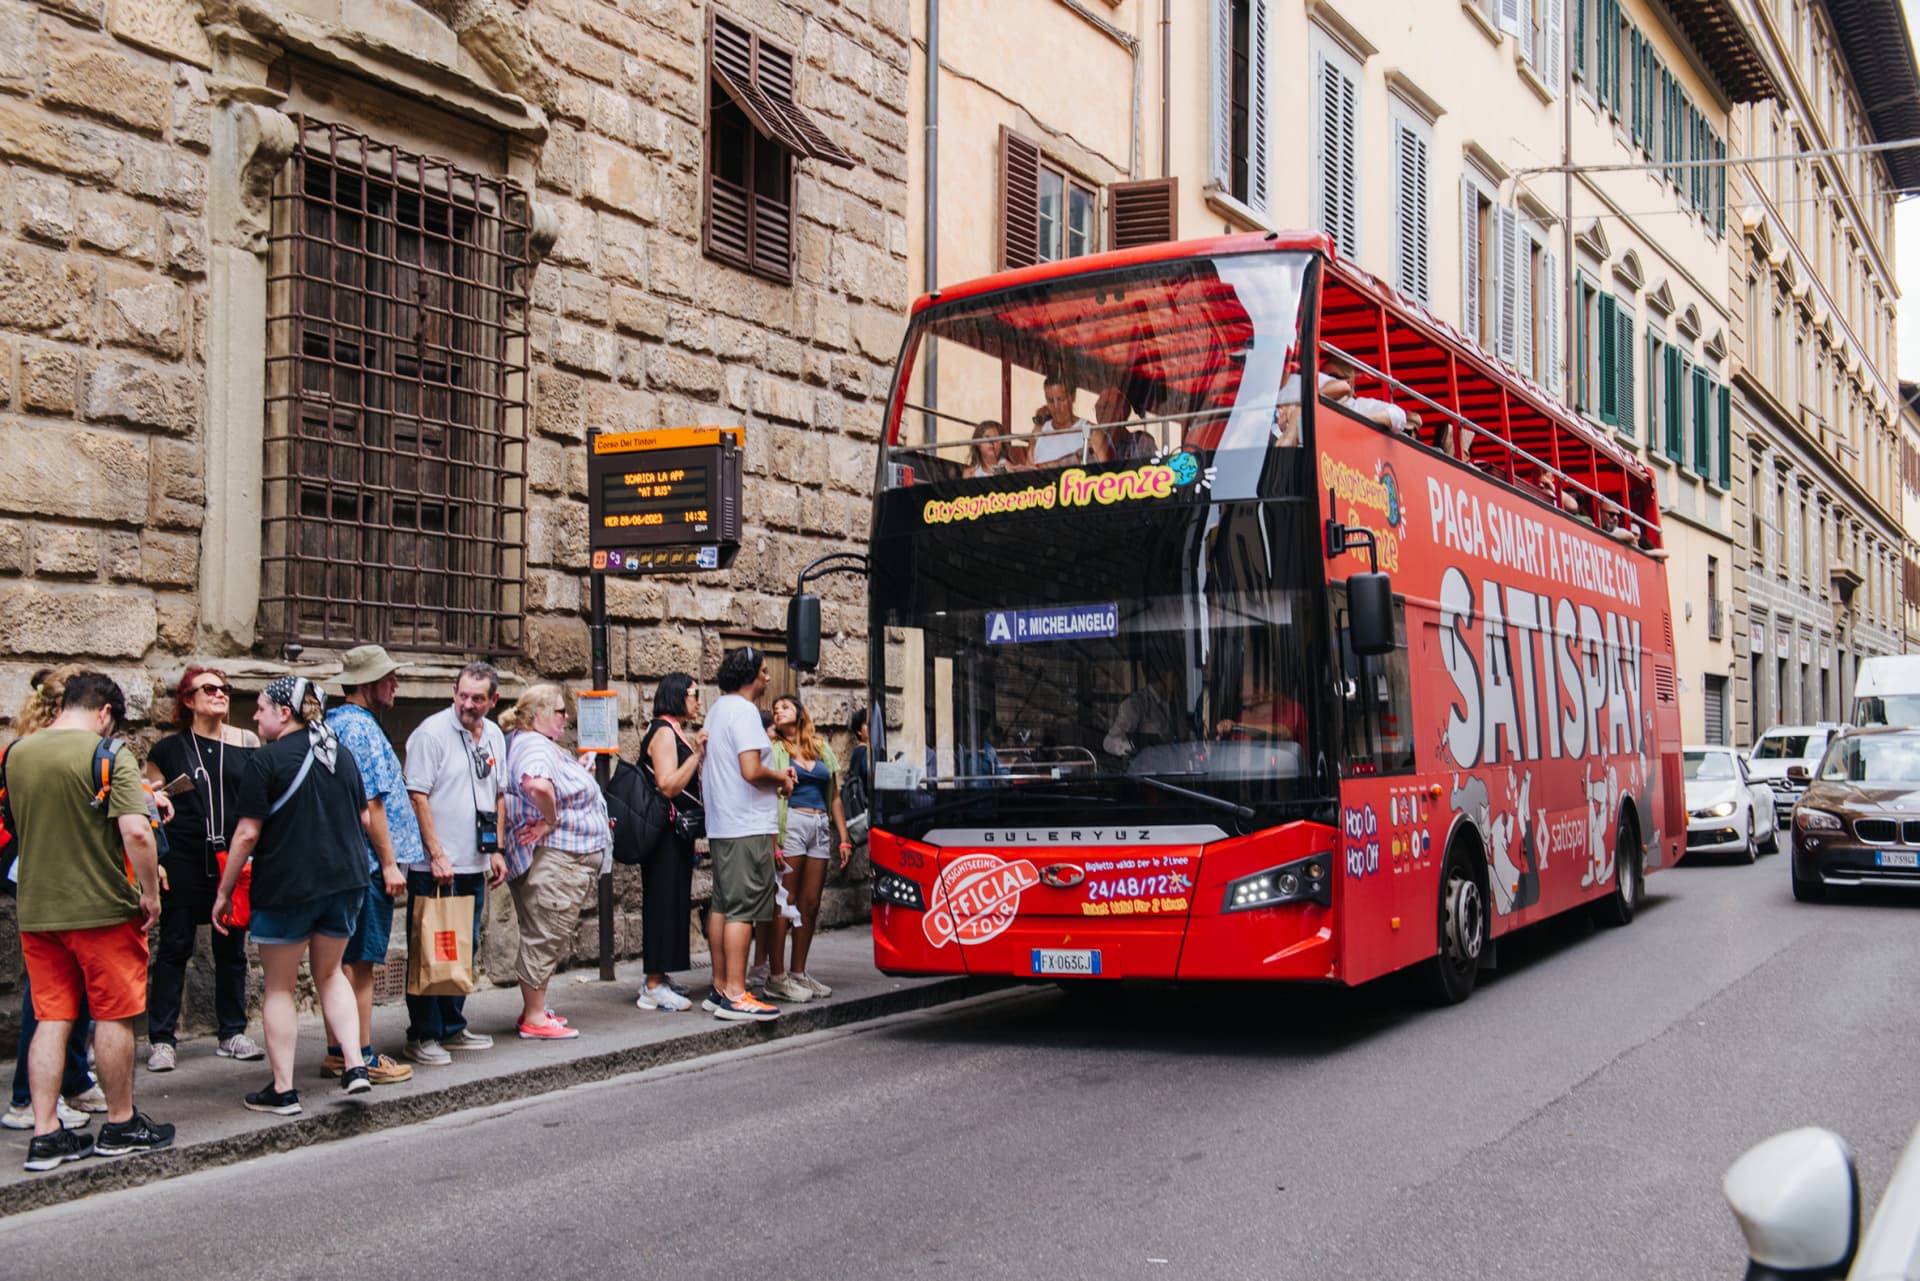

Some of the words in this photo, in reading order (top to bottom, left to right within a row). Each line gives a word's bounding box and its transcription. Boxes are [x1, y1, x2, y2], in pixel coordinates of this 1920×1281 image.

[597, 440, 618, 449] Corso
[620, 439, 632, 448] Dei
[634, 437, 657, 447] Tintori
[624, 472, 655, 485] SCARICA
[657, 471, 668, 482] LA
[670, 469, 685, 481] APP
[924, 485, 1056, 524] CitySightseeing
[1427, 476, 1487, 559] PAGA
[1487, 502, 1547, 577] SMART
[1549, 528, 1562, 582] A
[1560, 531, 1616, 598] FIRENZE
[1614, 556, 1640, 607] CON
[990, 613, 1011, 640] A
[1019, 618, 1027, 636] P.
[1030, 613, 1115, 635] MICHELANGELO
[1439, 566, 1642, 769] SATISPAY
[1345, 808, 1363, 839] Hop
[1365, 805, 1377, 835] On
[1552, 814, 1586, 860] satispay
[899, 849, 924, 869] 353
[1137, 859, 1150, 869] per
[1347, 848, 1364, 877] Hop
[1366, 842, 1379, 873] Off
[934, 865, 1032, 935] OFFICIAL
[1088, 875, 1168, 900] 24/48/72
[970, 902, 1014, 936] TOUR
[1042, 954, 1054, 969] FX
